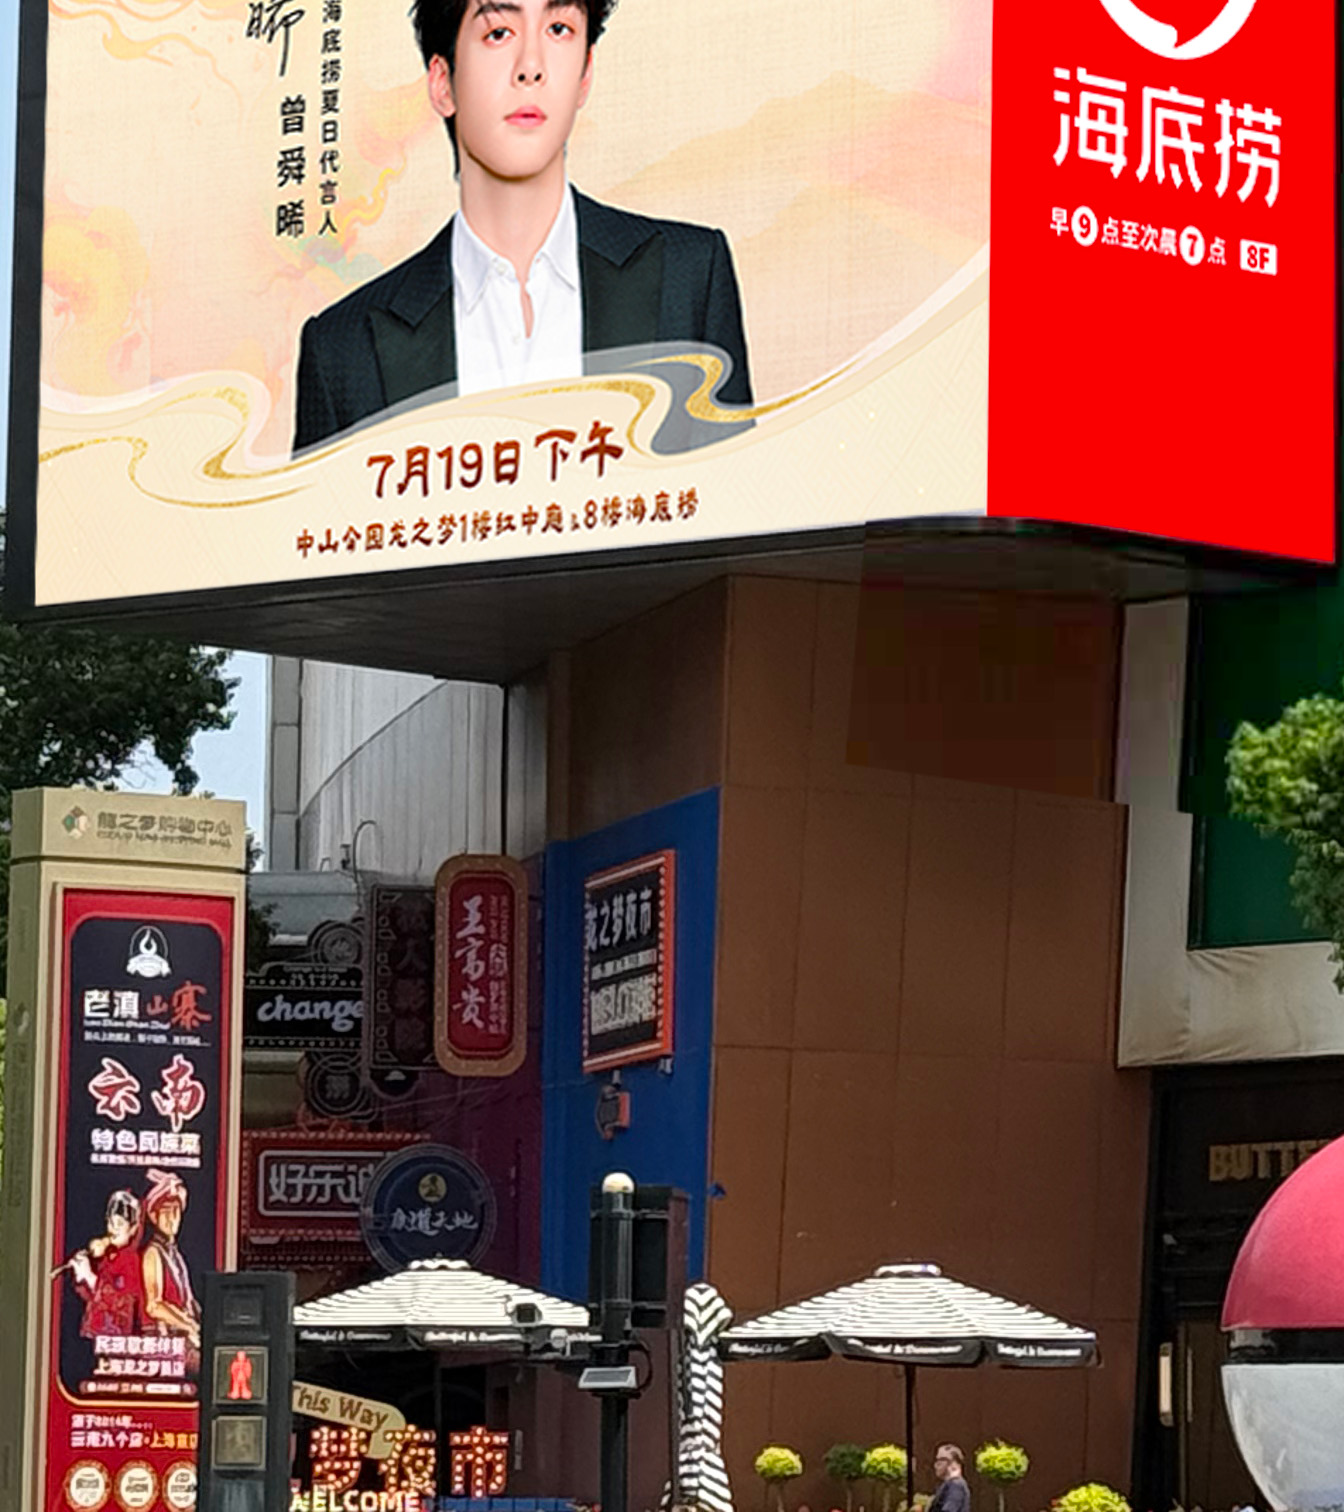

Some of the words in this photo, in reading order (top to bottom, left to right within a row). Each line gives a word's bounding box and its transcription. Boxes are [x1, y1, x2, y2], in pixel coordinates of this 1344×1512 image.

[318, 0, 342, 235] 海底捞夏日代言人
[1053, 67, 1282, 208] 海底捞
[275, 94, 306, 238] 曾舜晞
[1244, 242, 1273, 272] 8F
[1209, 1140, 1332, 1181] BUTT
[293, 1385, 329, 1414] his
[339, 1396, 389, 1431] Way
